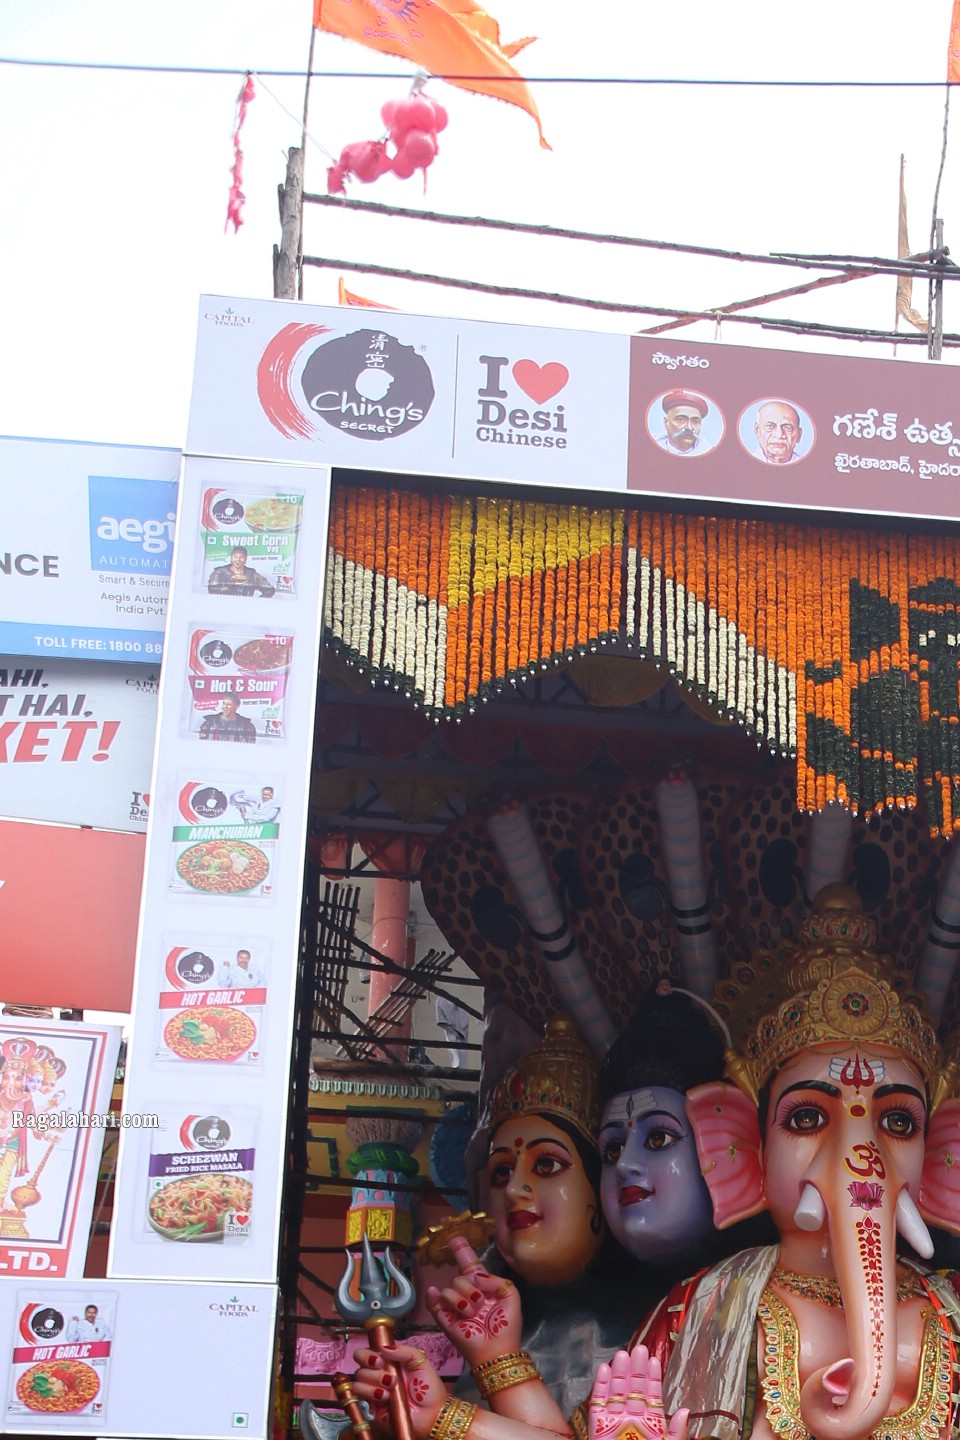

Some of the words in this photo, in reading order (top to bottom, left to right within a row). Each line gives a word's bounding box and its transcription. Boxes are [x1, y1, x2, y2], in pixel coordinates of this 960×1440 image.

[204, 312, 254, 325] CAPITAL
[215, 320, 244, 328] FOODS
[652, 351, 710, 370] స్వాగతం
[478, 356, 508, 398] I
[310, 391, 424, 426] Ching's
[477, 400, 568, 433] Desi
[340, 421, 394, 435] SECRET
[832, 408, 897, 441] గణేశ్
[475, 428, 567, 450] Chinese
[222, 535, 258, 547] Sweet
[262, 535, 289, 546] Corn
[267, 545, 279, 554] Veg
[99, 575, 126, 585] Smart
[101, 592, 131, 604] Aegis
[116, 605, 144, 614] India
[34, 637, 68, 648] TOLL
[71, 639, 107, 650] FREE:
[109, 640, 142, 652] 1800
[210, 679, 233, 693] Hot
[235, 679, 245, 692] &
[248, 679, 278, 692] Sour
[18, 694, 94, 718] HAI,
[188, 826, 264, 840] MANCHURIAN
[181, 992, 206, 1006] HOT
[206, 991, 245, 1005] GARLIC
[172, 1153, 238, 1165] SCHEZWAN
[165, 1166, 190, 1174] FRIED
[190, 1164, 209, 1172] RICE
[210, 1162, 243, 1171] MASALA
[209, 1302, 260, 1313] CAPITAL
[32, 1348, 54, 1361] HOT
[56, 1345, 92, 1359] GARLIC
